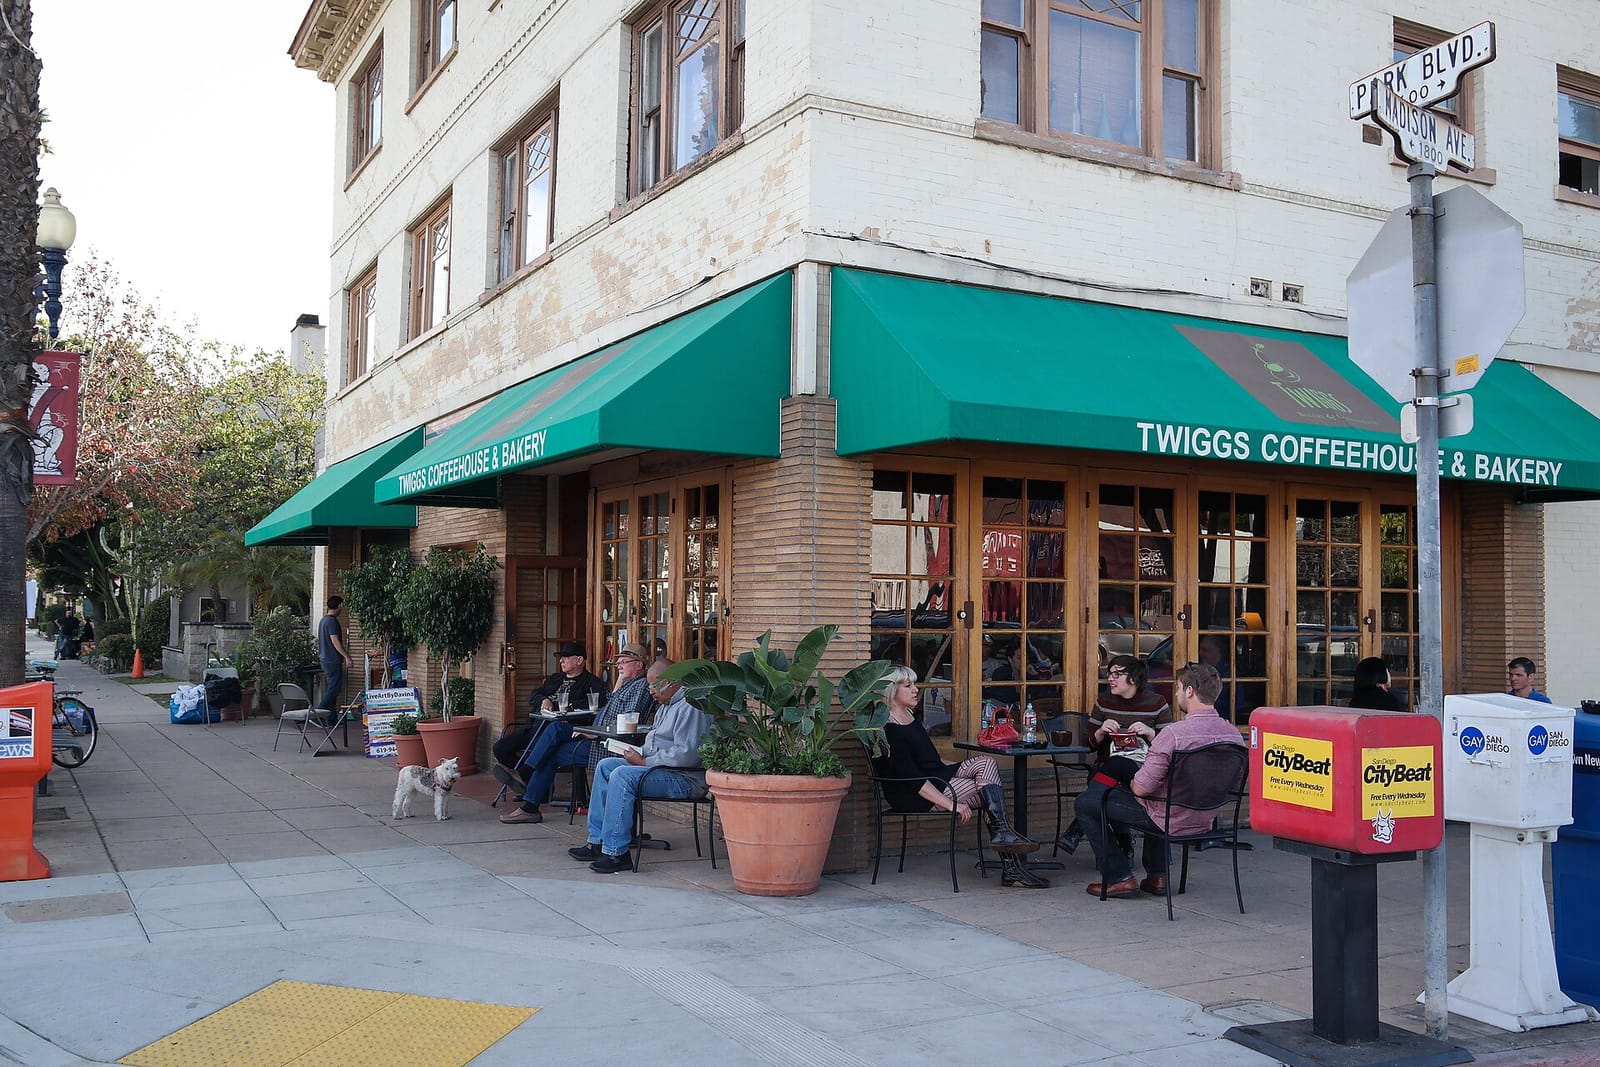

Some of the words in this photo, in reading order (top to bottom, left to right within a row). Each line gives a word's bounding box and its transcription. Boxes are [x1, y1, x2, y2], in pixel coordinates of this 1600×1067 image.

[1356, 63, 1408, 110] PRK
[1422, 35, 1482, 80] BLVD.
[1385, 92, 1437, 145] MADISON
[1446, 126, 1471, 162] AVE.
[1419, 145, 1443, 165] 1800
[398, 468, 427, 495] TWIGGS
[427, 448, 490, 487] COFFEEHOUSE
[491, 446, 499, 470] &
[502, 429, 548, 467] BAKERY
[1137, 422, 1250, 460] TWIGGS
[1261, 433, 1444, 476] COFFEEHOU
[1451, 451, 1467, 477] &
[1475, 454, 1563, 486] BAKERY
[1461, 735, 1483, 748] GAY
[1486, 735, 1502, 744] SAN
[1486, 744, 1510, 753] DIEGO
[1529, 735, 1548, 747] GAY
[1549, 731, 1563, 739] SAN
[1548, 738, 1569, 747] DIEGO
[1264, 749, 1331, 776] CityBeat
[1270, 776, 1280, 784] Free
[1281, 777, 1294, 788] Every
[1295, 780, 1325, 793] Wednesday
[1363, 763, 1432, 787] CityBeat
[1370, 793, 1381, 801] Free
[1382, 793, 1395, 802] Every
[1397, 792, 1426, 801] Wednesday
